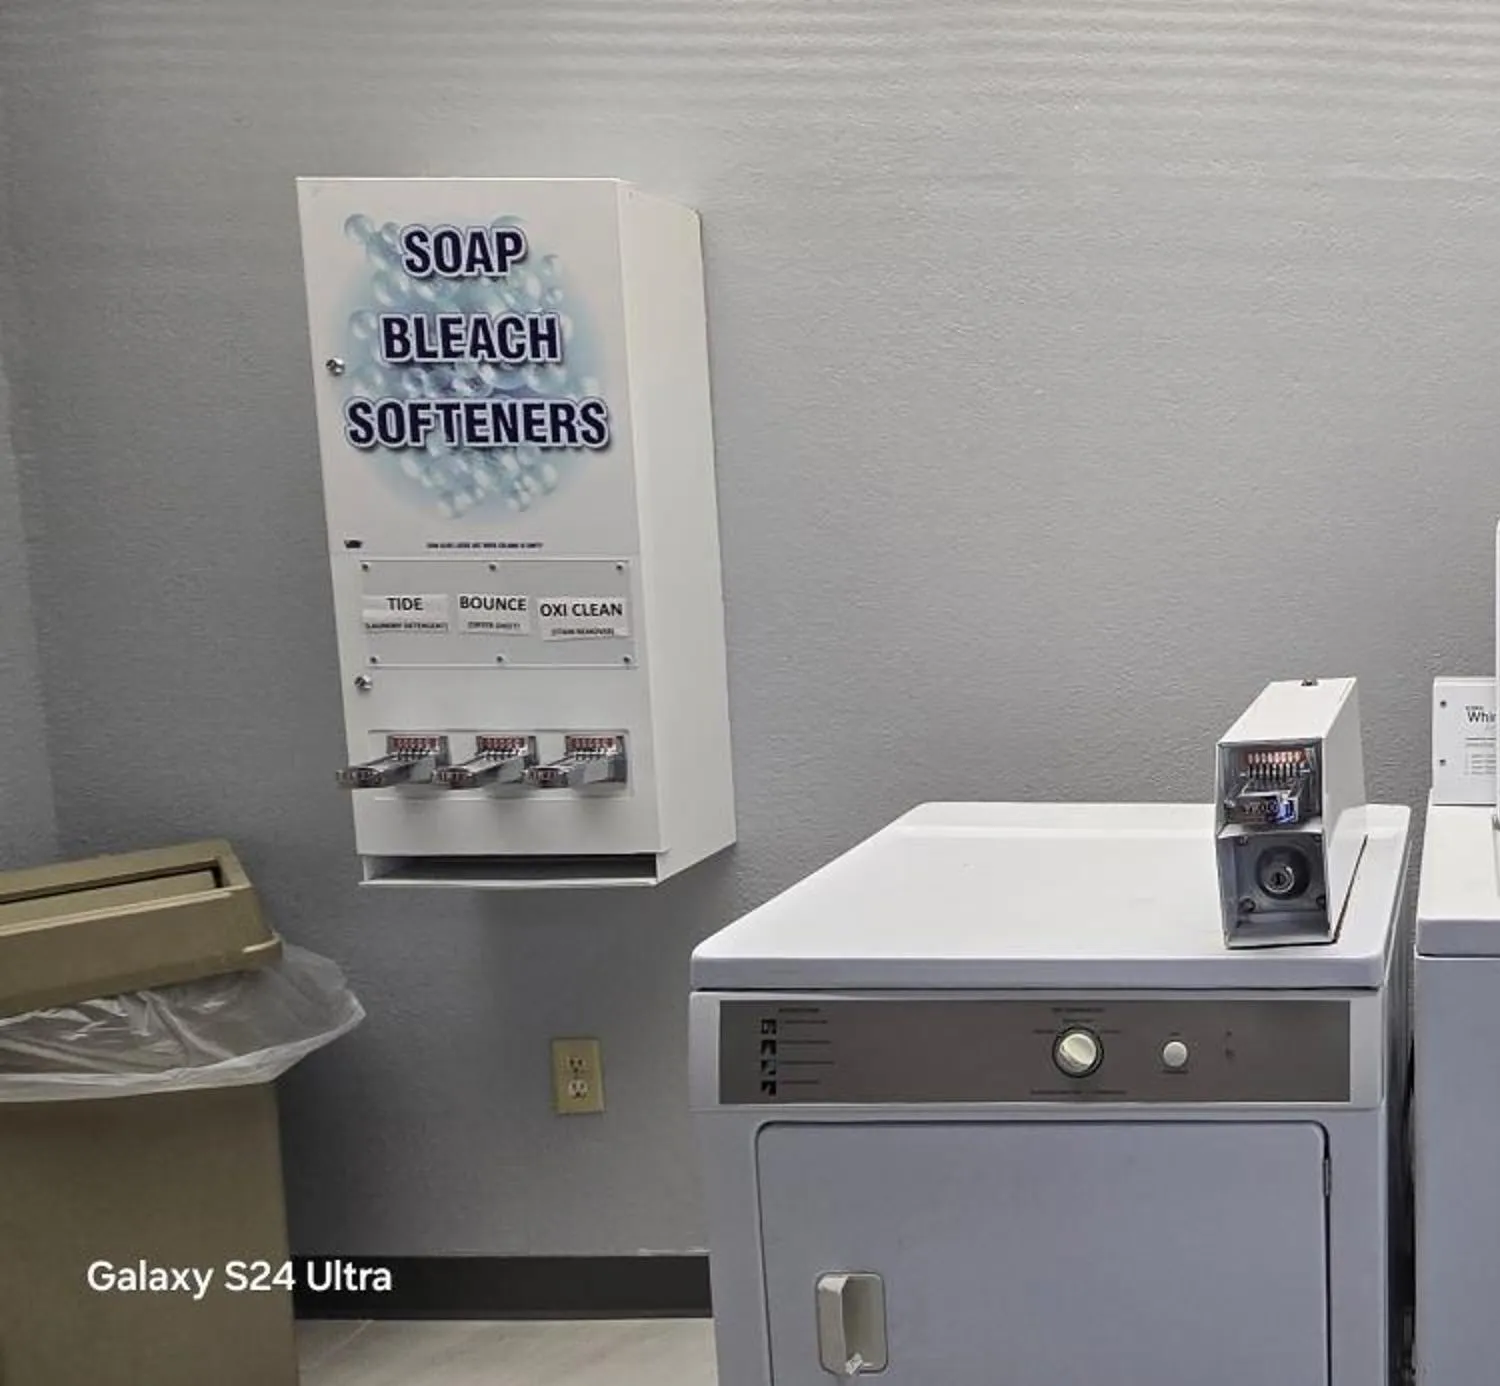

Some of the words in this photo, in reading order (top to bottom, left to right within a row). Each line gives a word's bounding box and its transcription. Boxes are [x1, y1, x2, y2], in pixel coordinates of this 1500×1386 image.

[402, 227, 527, 276] SOAP
[380, 315, 562, 362] BLEACH
[345, 399, 609, 447] SOFTENERS
[386, 597, 424, 611] TIDE
[459, 596, 527, 611] BOUNCE
[540, 604, 567, 617] OXI
[572, 603, 623, 617] CLEAN
